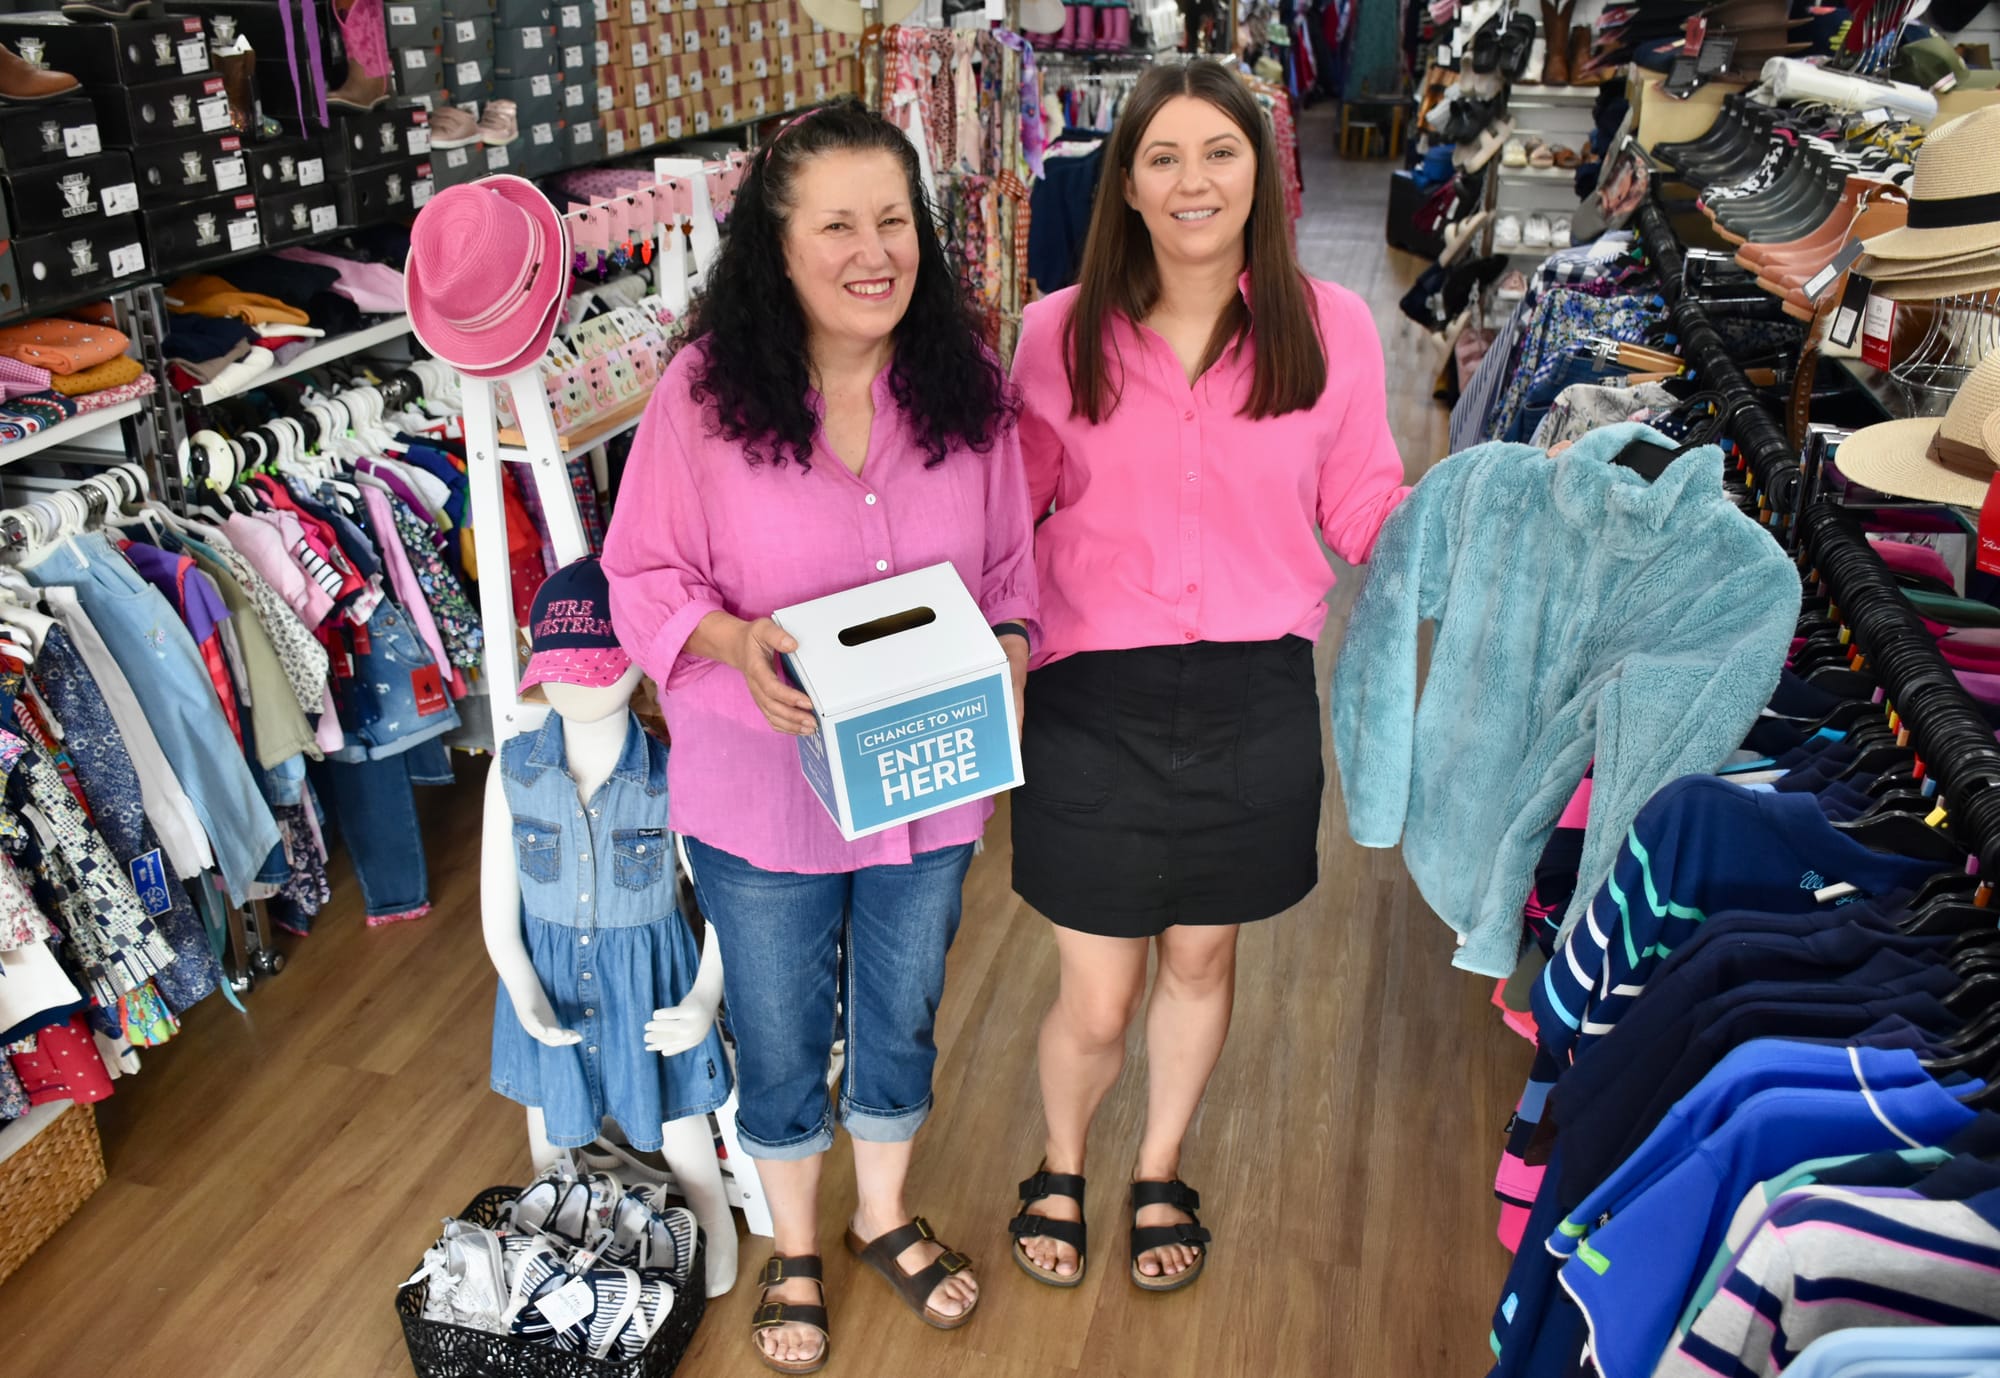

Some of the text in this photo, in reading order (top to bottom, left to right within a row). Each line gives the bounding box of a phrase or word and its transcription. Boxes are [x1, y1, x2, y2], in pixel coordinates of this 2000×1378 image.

[534, 616, 612, 639] WESTERN
[545, 600, 594, 619] PURE
[863, 702, 982, 748] CHANCE TO WIN
[877, 728, 976, 777] ENTER
[881, 751, 980, 807] HERE
